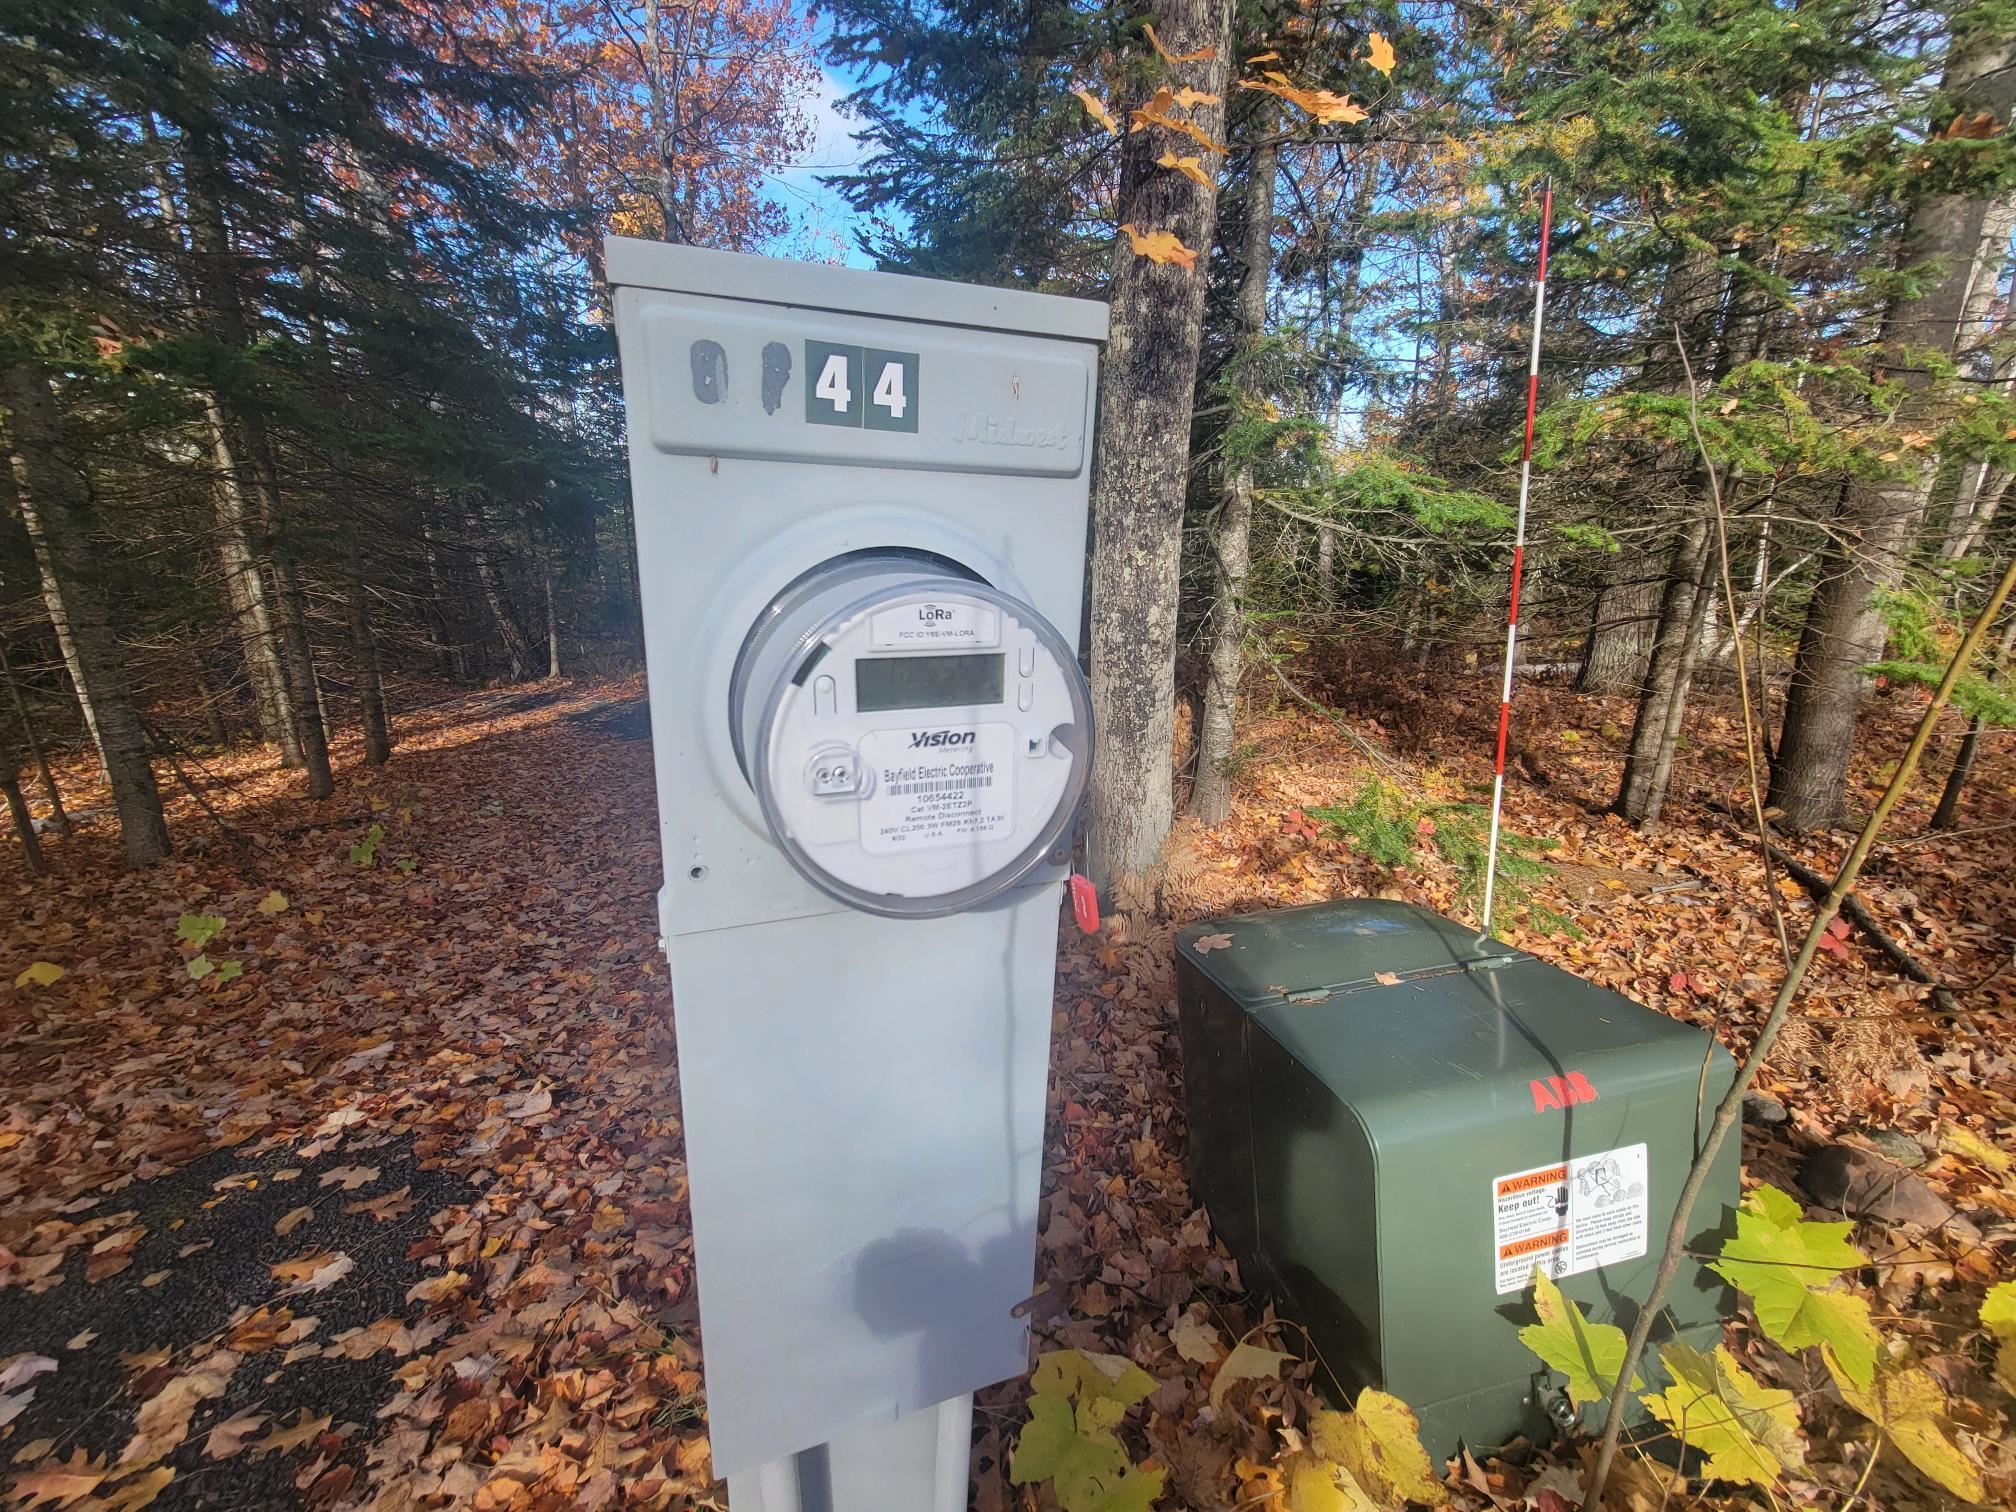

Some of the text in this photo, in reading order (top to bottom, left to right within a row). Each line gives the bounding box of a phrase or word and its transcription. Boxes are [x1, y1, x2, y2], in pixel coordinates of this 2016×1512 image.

[815, 354, 908, 419] 44
[919, 608, 953, 621] LoRa
[908, 730, 976, 749] Vision
[884, 761, 994, 784] Bayfield Electric Cooperative
[905, 809, 981, 823] Remote Disconnect
[1529, 1071, 1597, 1113] ABB
[1512, 1169, 1567, 1191] WARNING
[1497, 1192, 1525, 1203] Hazardous
[1498, 1195, 1540, 1213] Keep out!
[1499, 1224, 1519, 1234] Bayfield
[1519, 1220, 1537, 1229] Electric
[1515, 1233, 1567, 1254] WARNING
[1500, 1246, 1569, 1269] Underground power cables
[1500, 1269, 1509, 1277] are
[1509, 1263, 1529, 1273] located
